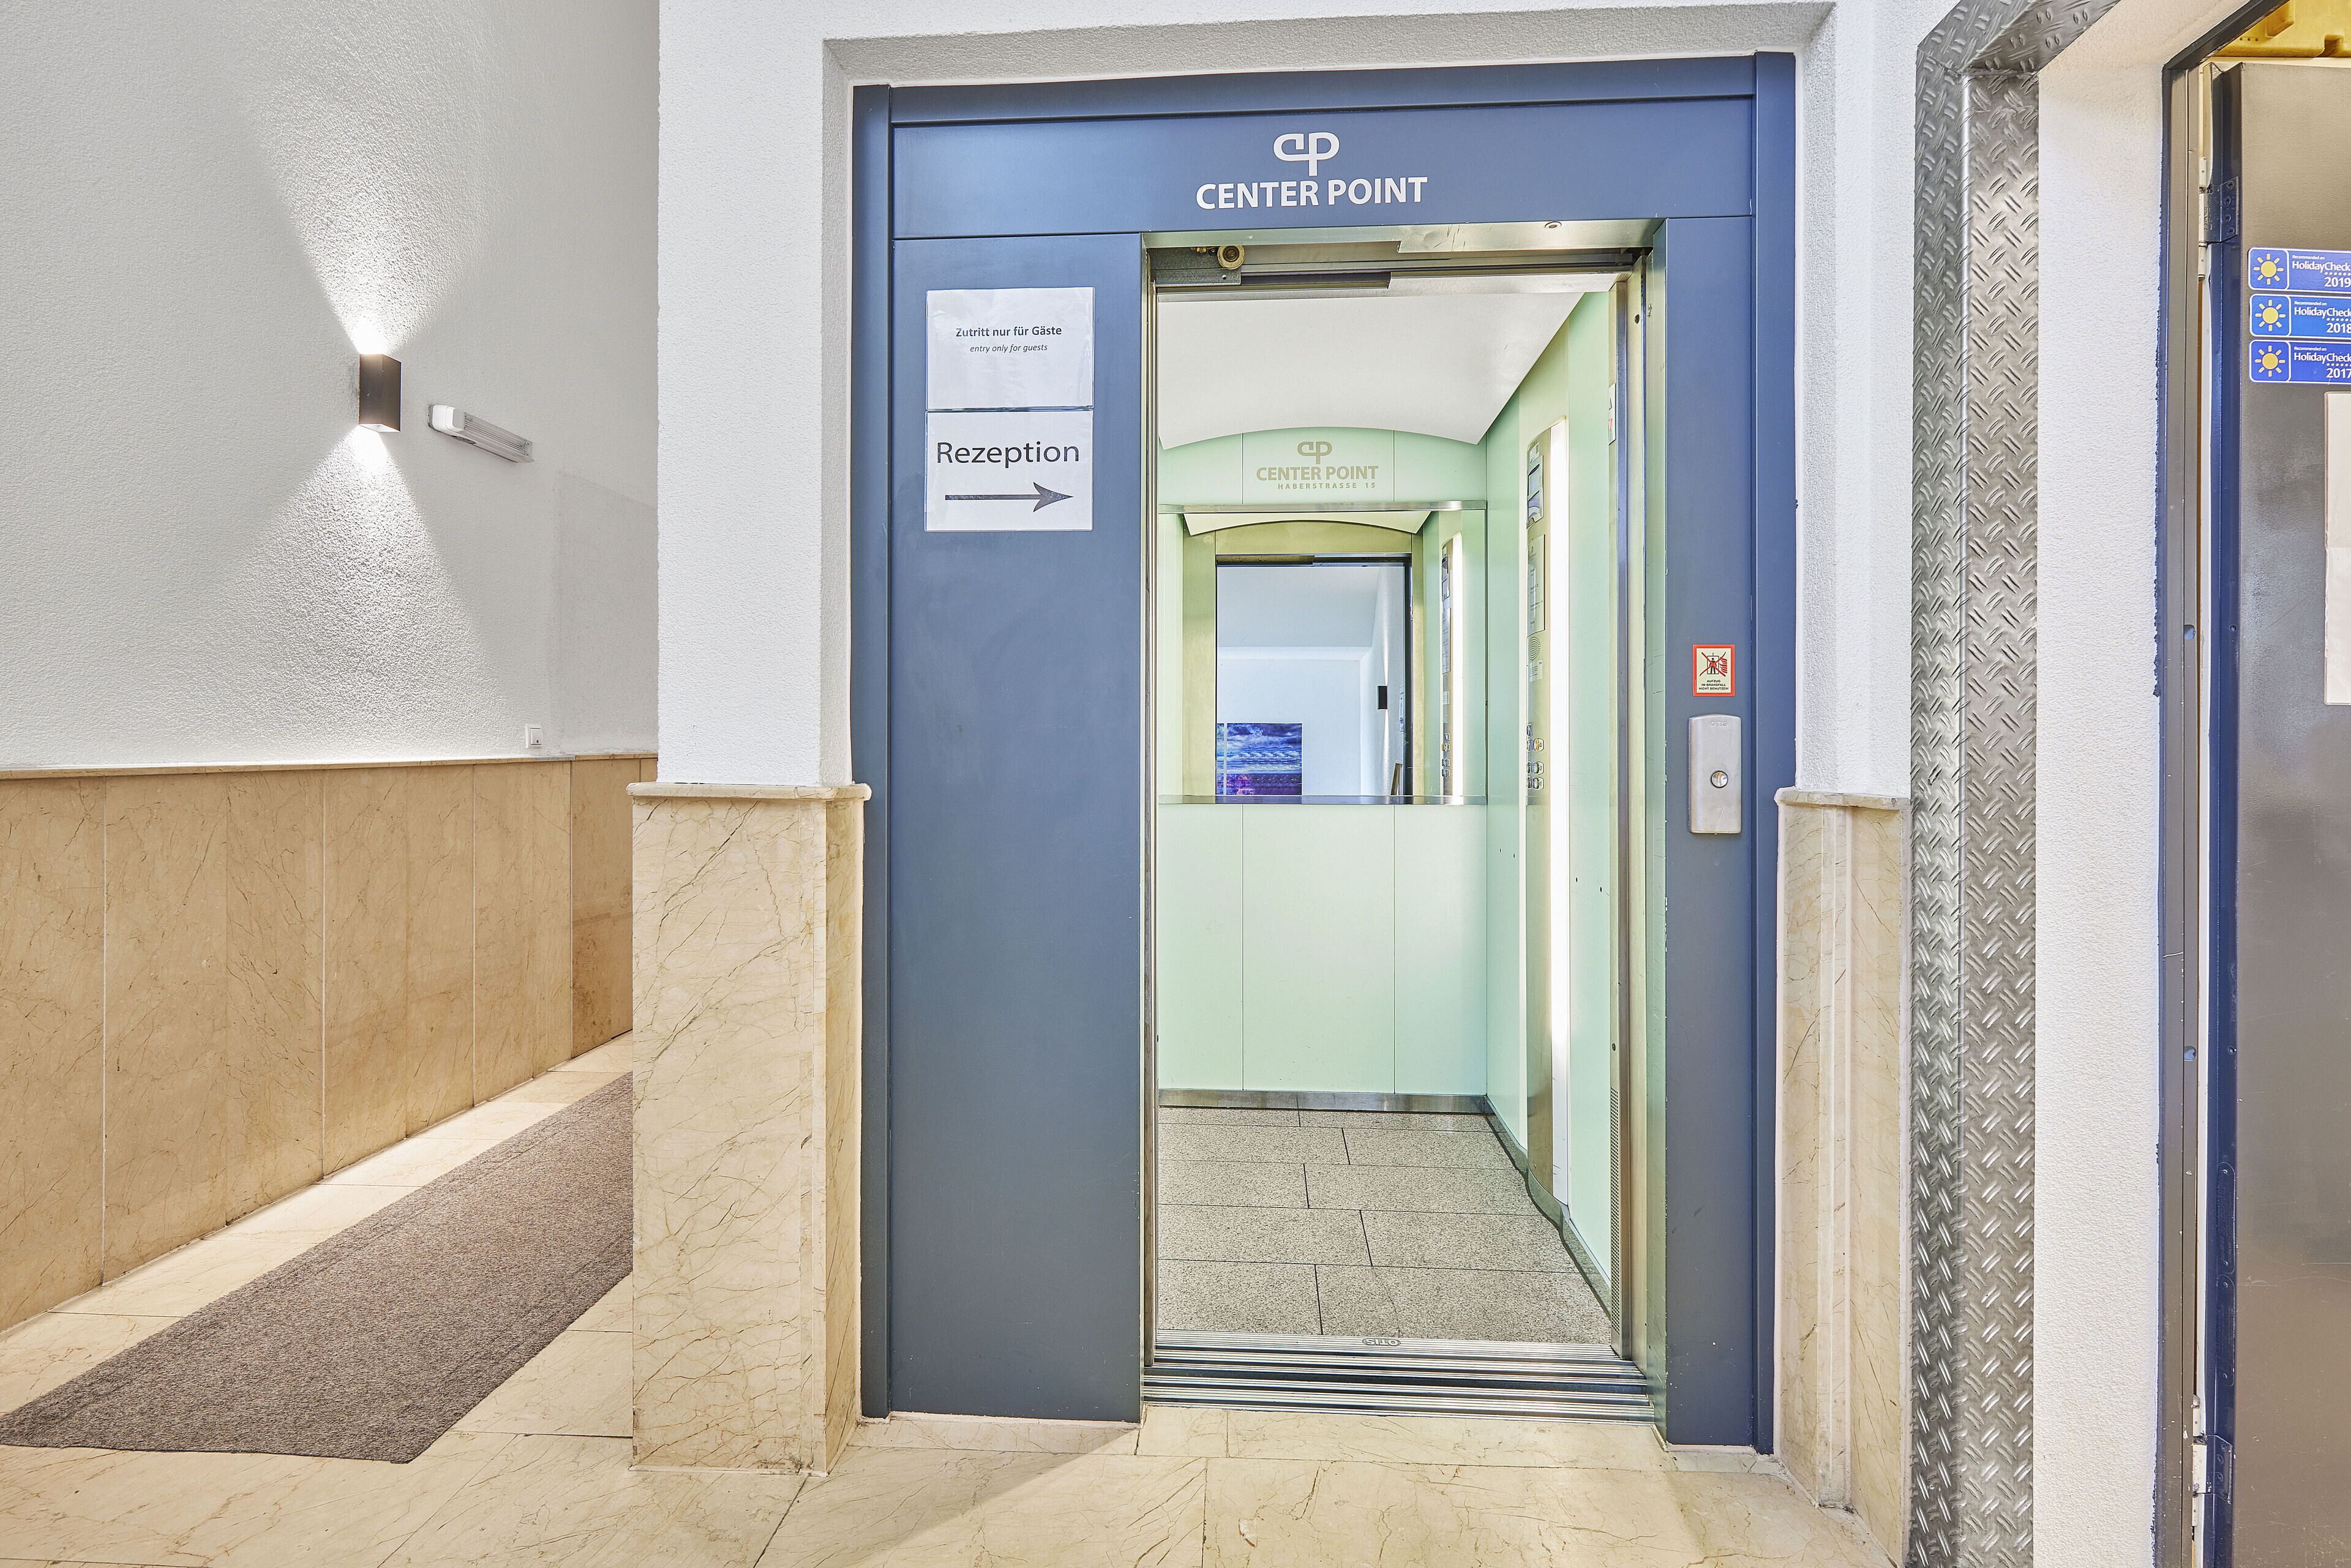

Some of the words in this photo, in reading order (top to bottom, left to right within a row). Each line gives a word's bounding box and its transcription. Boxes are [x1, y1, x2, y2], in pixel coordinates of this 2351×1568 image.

[1196, 179, 1319, 209] CENTER
[1328, 176, 1428, 205] POINT
[2292, 261, 2351, 273] HolidayCheck
[2324, 276, 2351, 288] 2019
[956, 327, 990, 337] Zutritt
[992, 328, 1011, 337] nur
[1013, 326, 1029, 336] für
[1032, 326, 1062, 336] Gäste
[2327, 323, 2351, 334] 2018
[970, 345, 990, 354] entry
[992, 344, 1009, 353] only
[1009, 343, 1021, 353] for
[1022, 344, 1048, 353] guests
[2326, 367, 2351, 378] 2017
[937, 441, 1079, 468] Rezeption
[1256, 467, 1321, 481] CENTER
[1325, 465, 1378, 480] POINT
